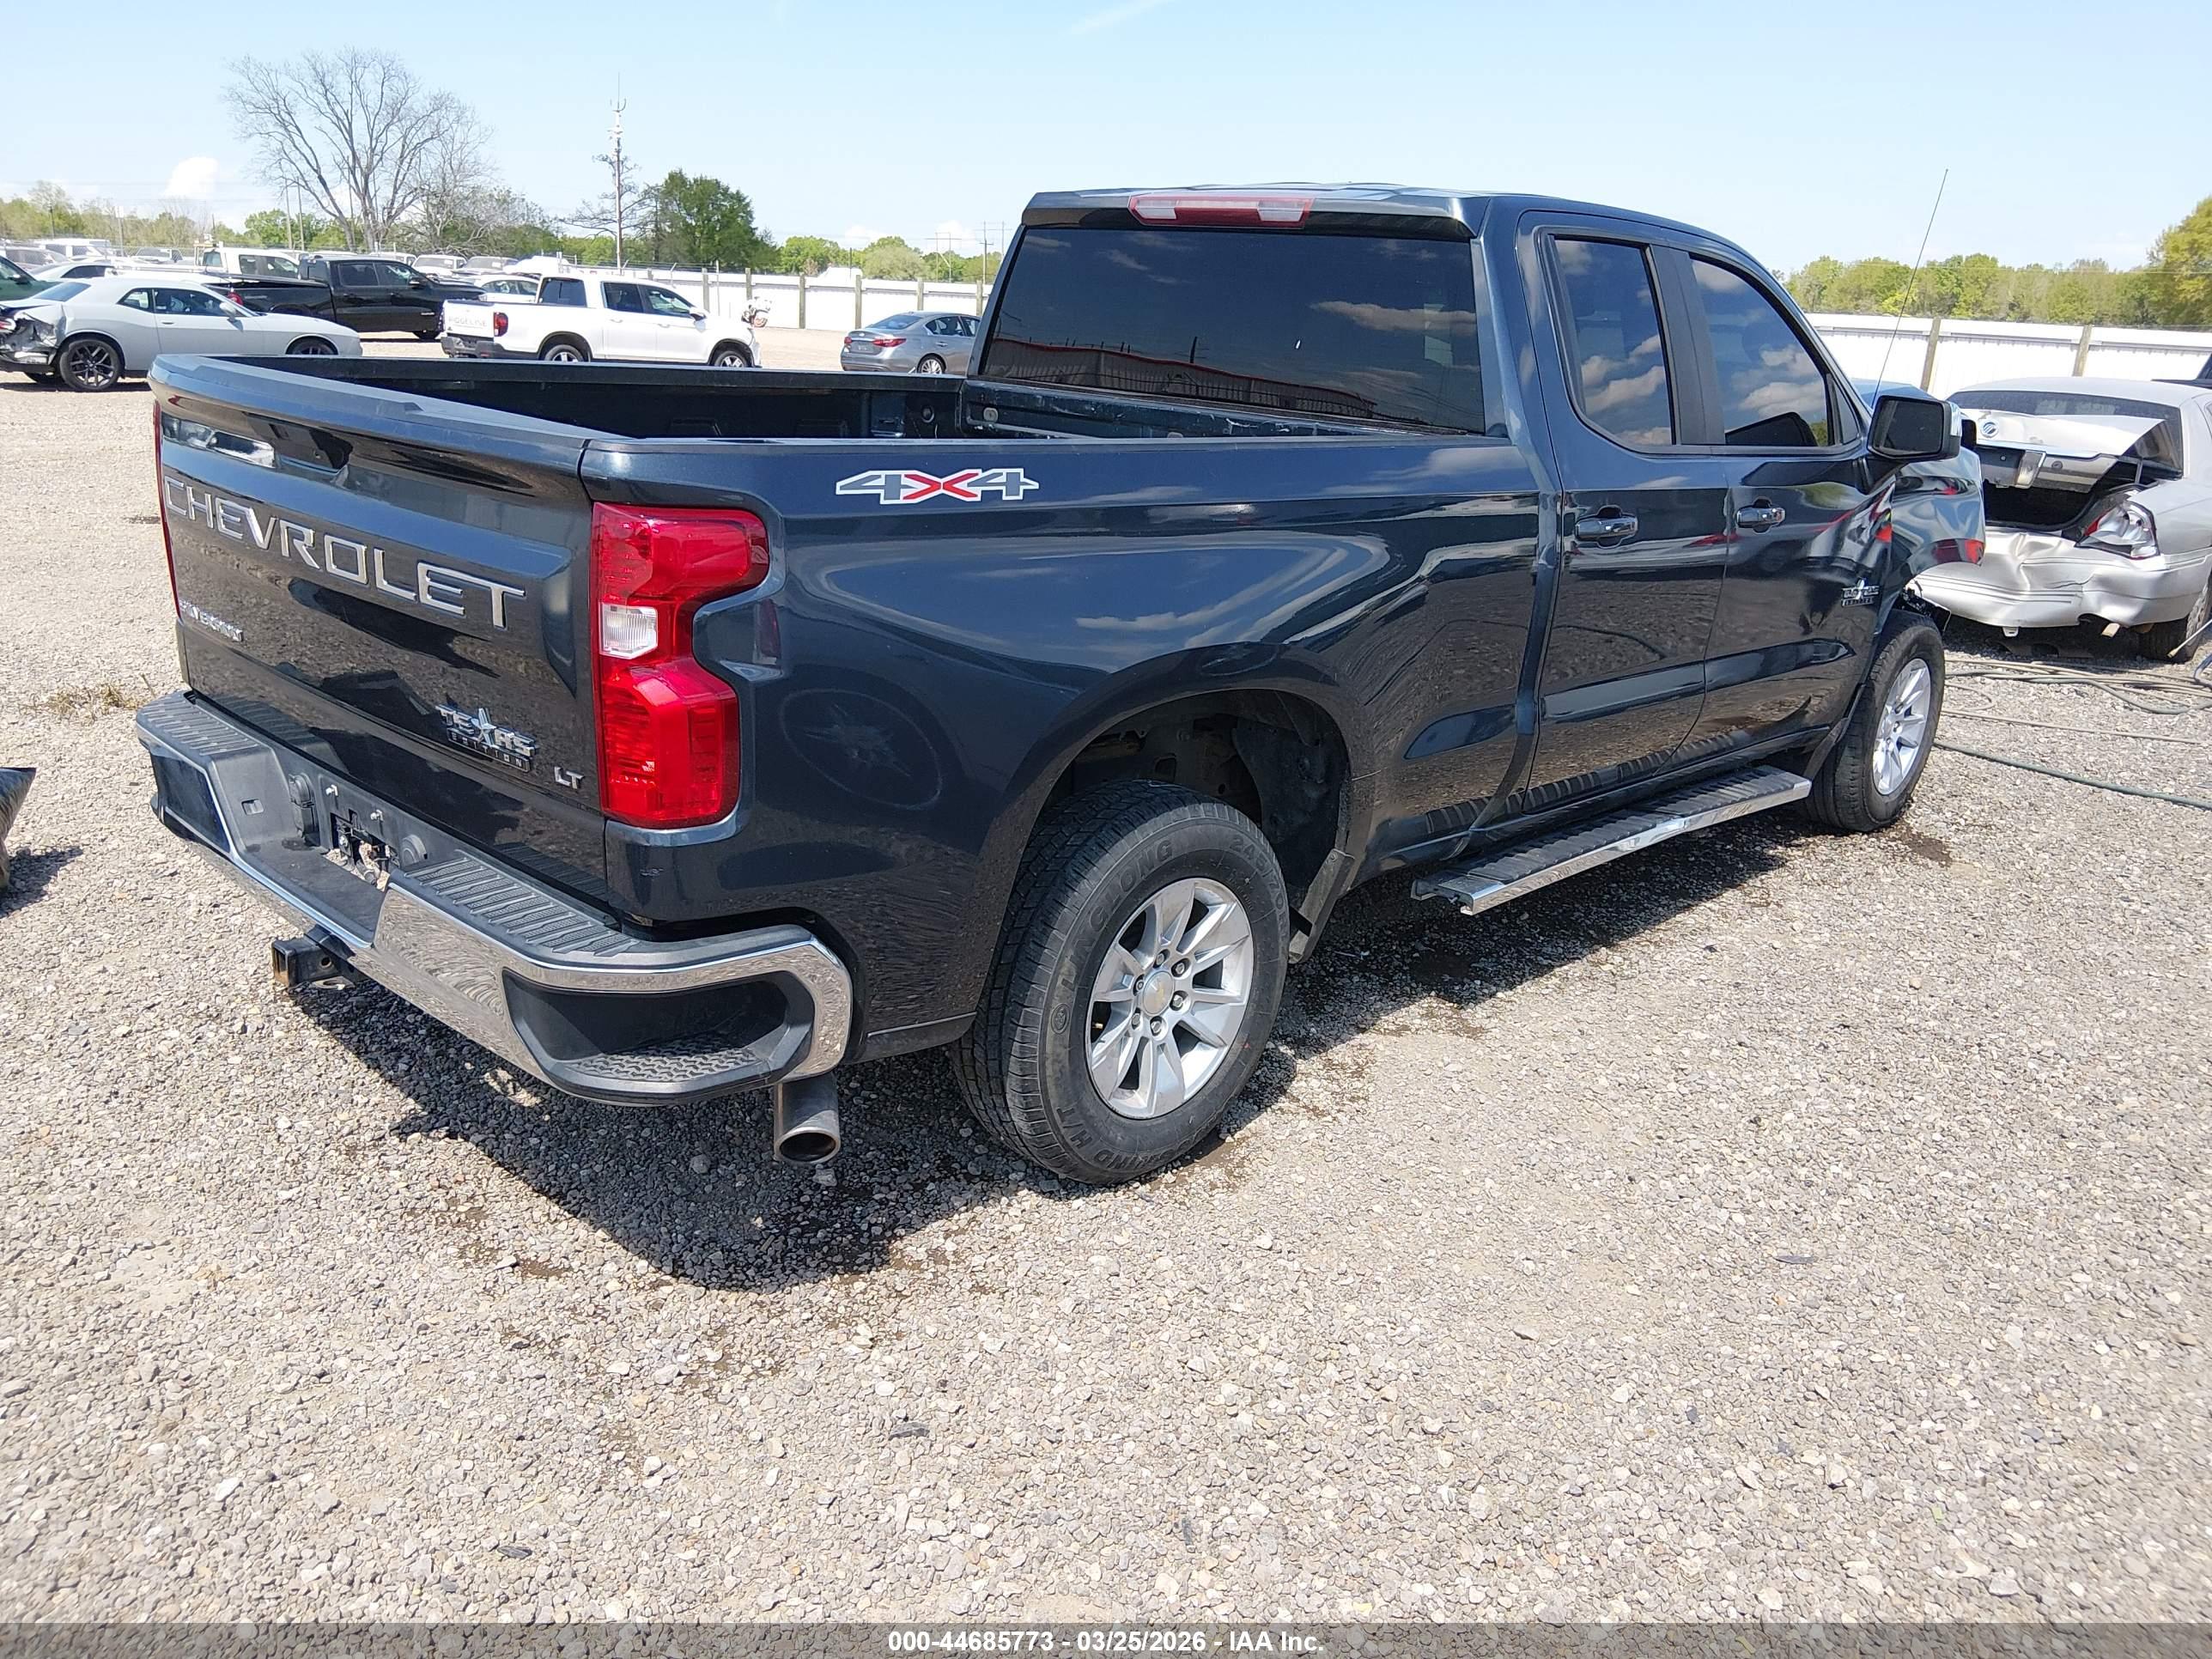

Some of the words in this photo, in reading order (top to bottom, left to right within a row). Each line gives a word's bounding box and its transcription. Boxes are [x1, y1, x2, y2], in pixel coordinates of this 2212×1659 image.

[164, 475, 526, 631] CHEVROLET
[435, 705, 537, 757] TEXAS
[554, 766, 585, 789] LT
